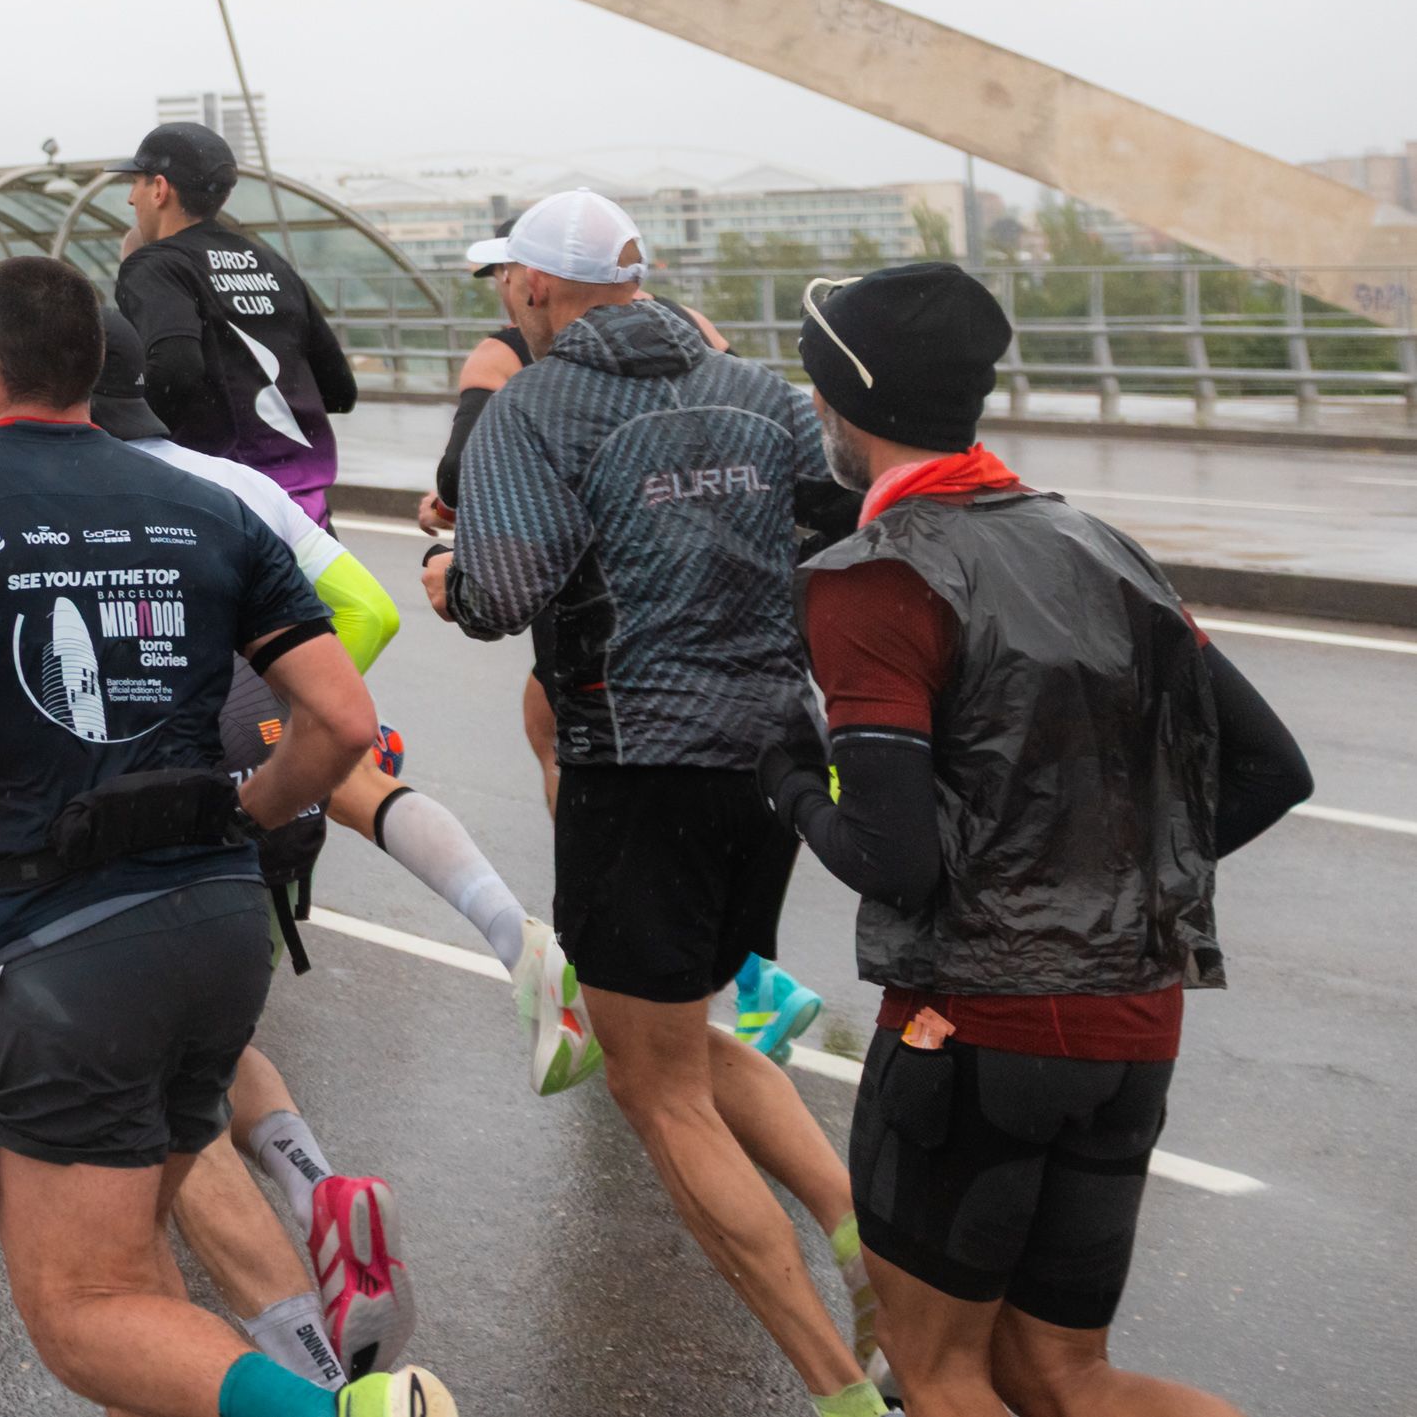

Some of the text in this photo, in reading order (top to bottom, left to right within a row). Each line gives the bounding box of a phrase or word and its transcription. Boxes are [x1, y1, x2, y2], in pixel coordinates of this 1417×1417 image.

[207, 249, 258, 270] BIRDS
[232, 295, 275, 315] CLUB
[83, 529, 130, 538] GoPro
[144, 526, 197, 537] NOVOTEL
[7, 569, 180, 590] SEE YOU AT THE TOP
[97, 590, 183, 599] BARCELONA
[99, 600, 185, 637] MIRADOR
[139, 639, 172, 651] torre
[140, 653, 188, 666] Glòries
[107, 686, 173, 694] official edition of the
[109, 694, 172, 703] Tower Running Tour
[295, 1323, 342, 1381] RUNNING
